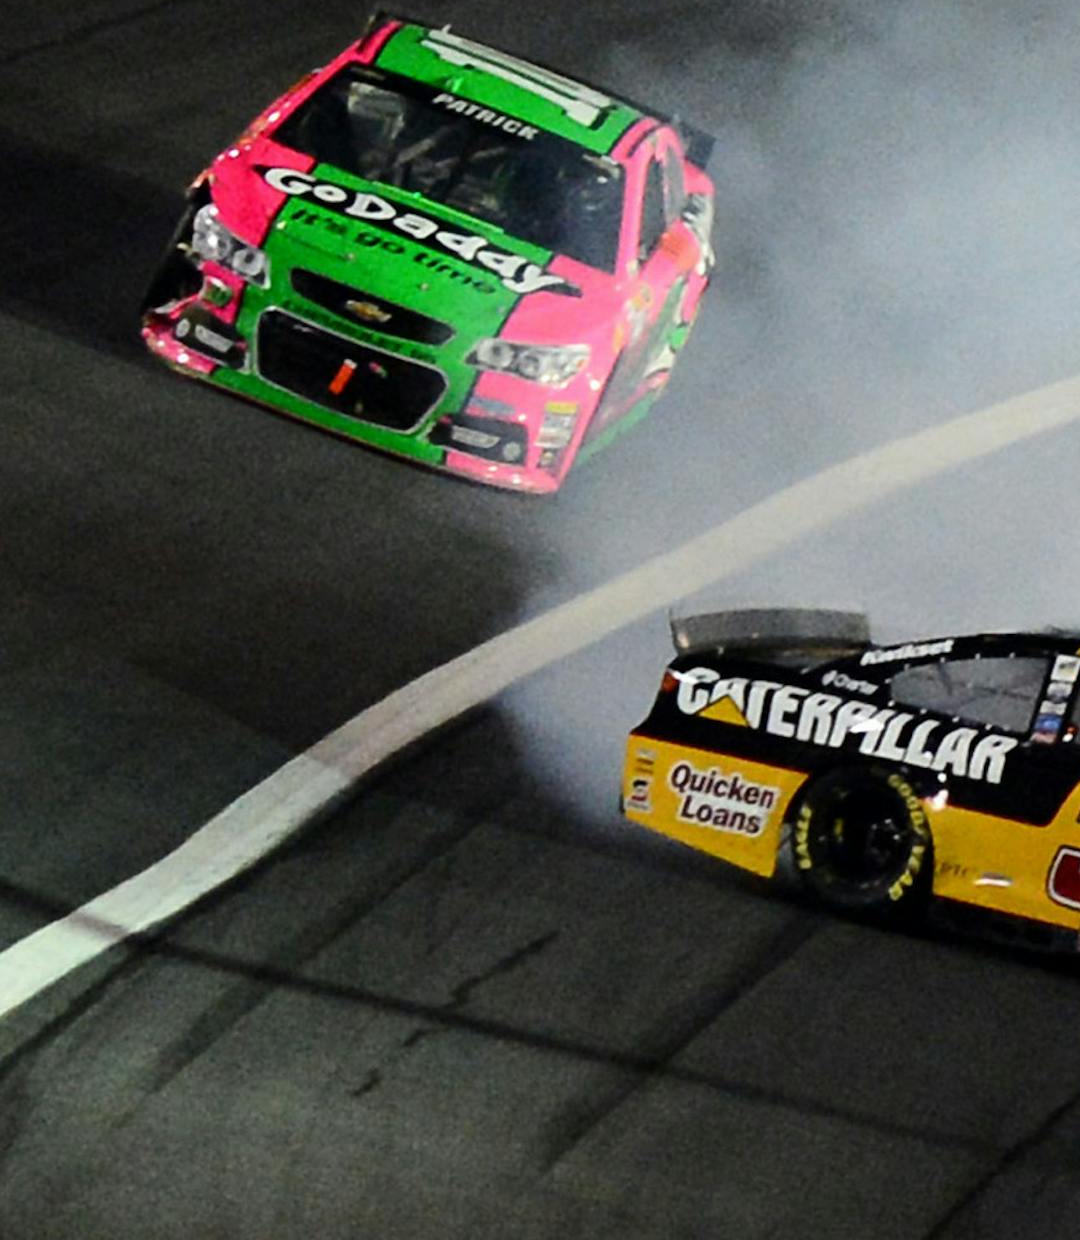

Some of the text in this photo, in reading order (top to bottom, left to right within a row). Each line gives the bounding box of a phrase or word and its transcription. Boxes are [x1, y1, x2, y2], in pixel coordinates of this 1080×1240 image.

[432, 92, 539, 141] PATRICK
[265, 168, 564, 293] GoDaddy
[355, 229, 405, 257] go
[677, 667, 1018, 783] CATERPILLAR
[671, 764, 776, 809] Quicken
[680, 795, 763, 835] Loans
